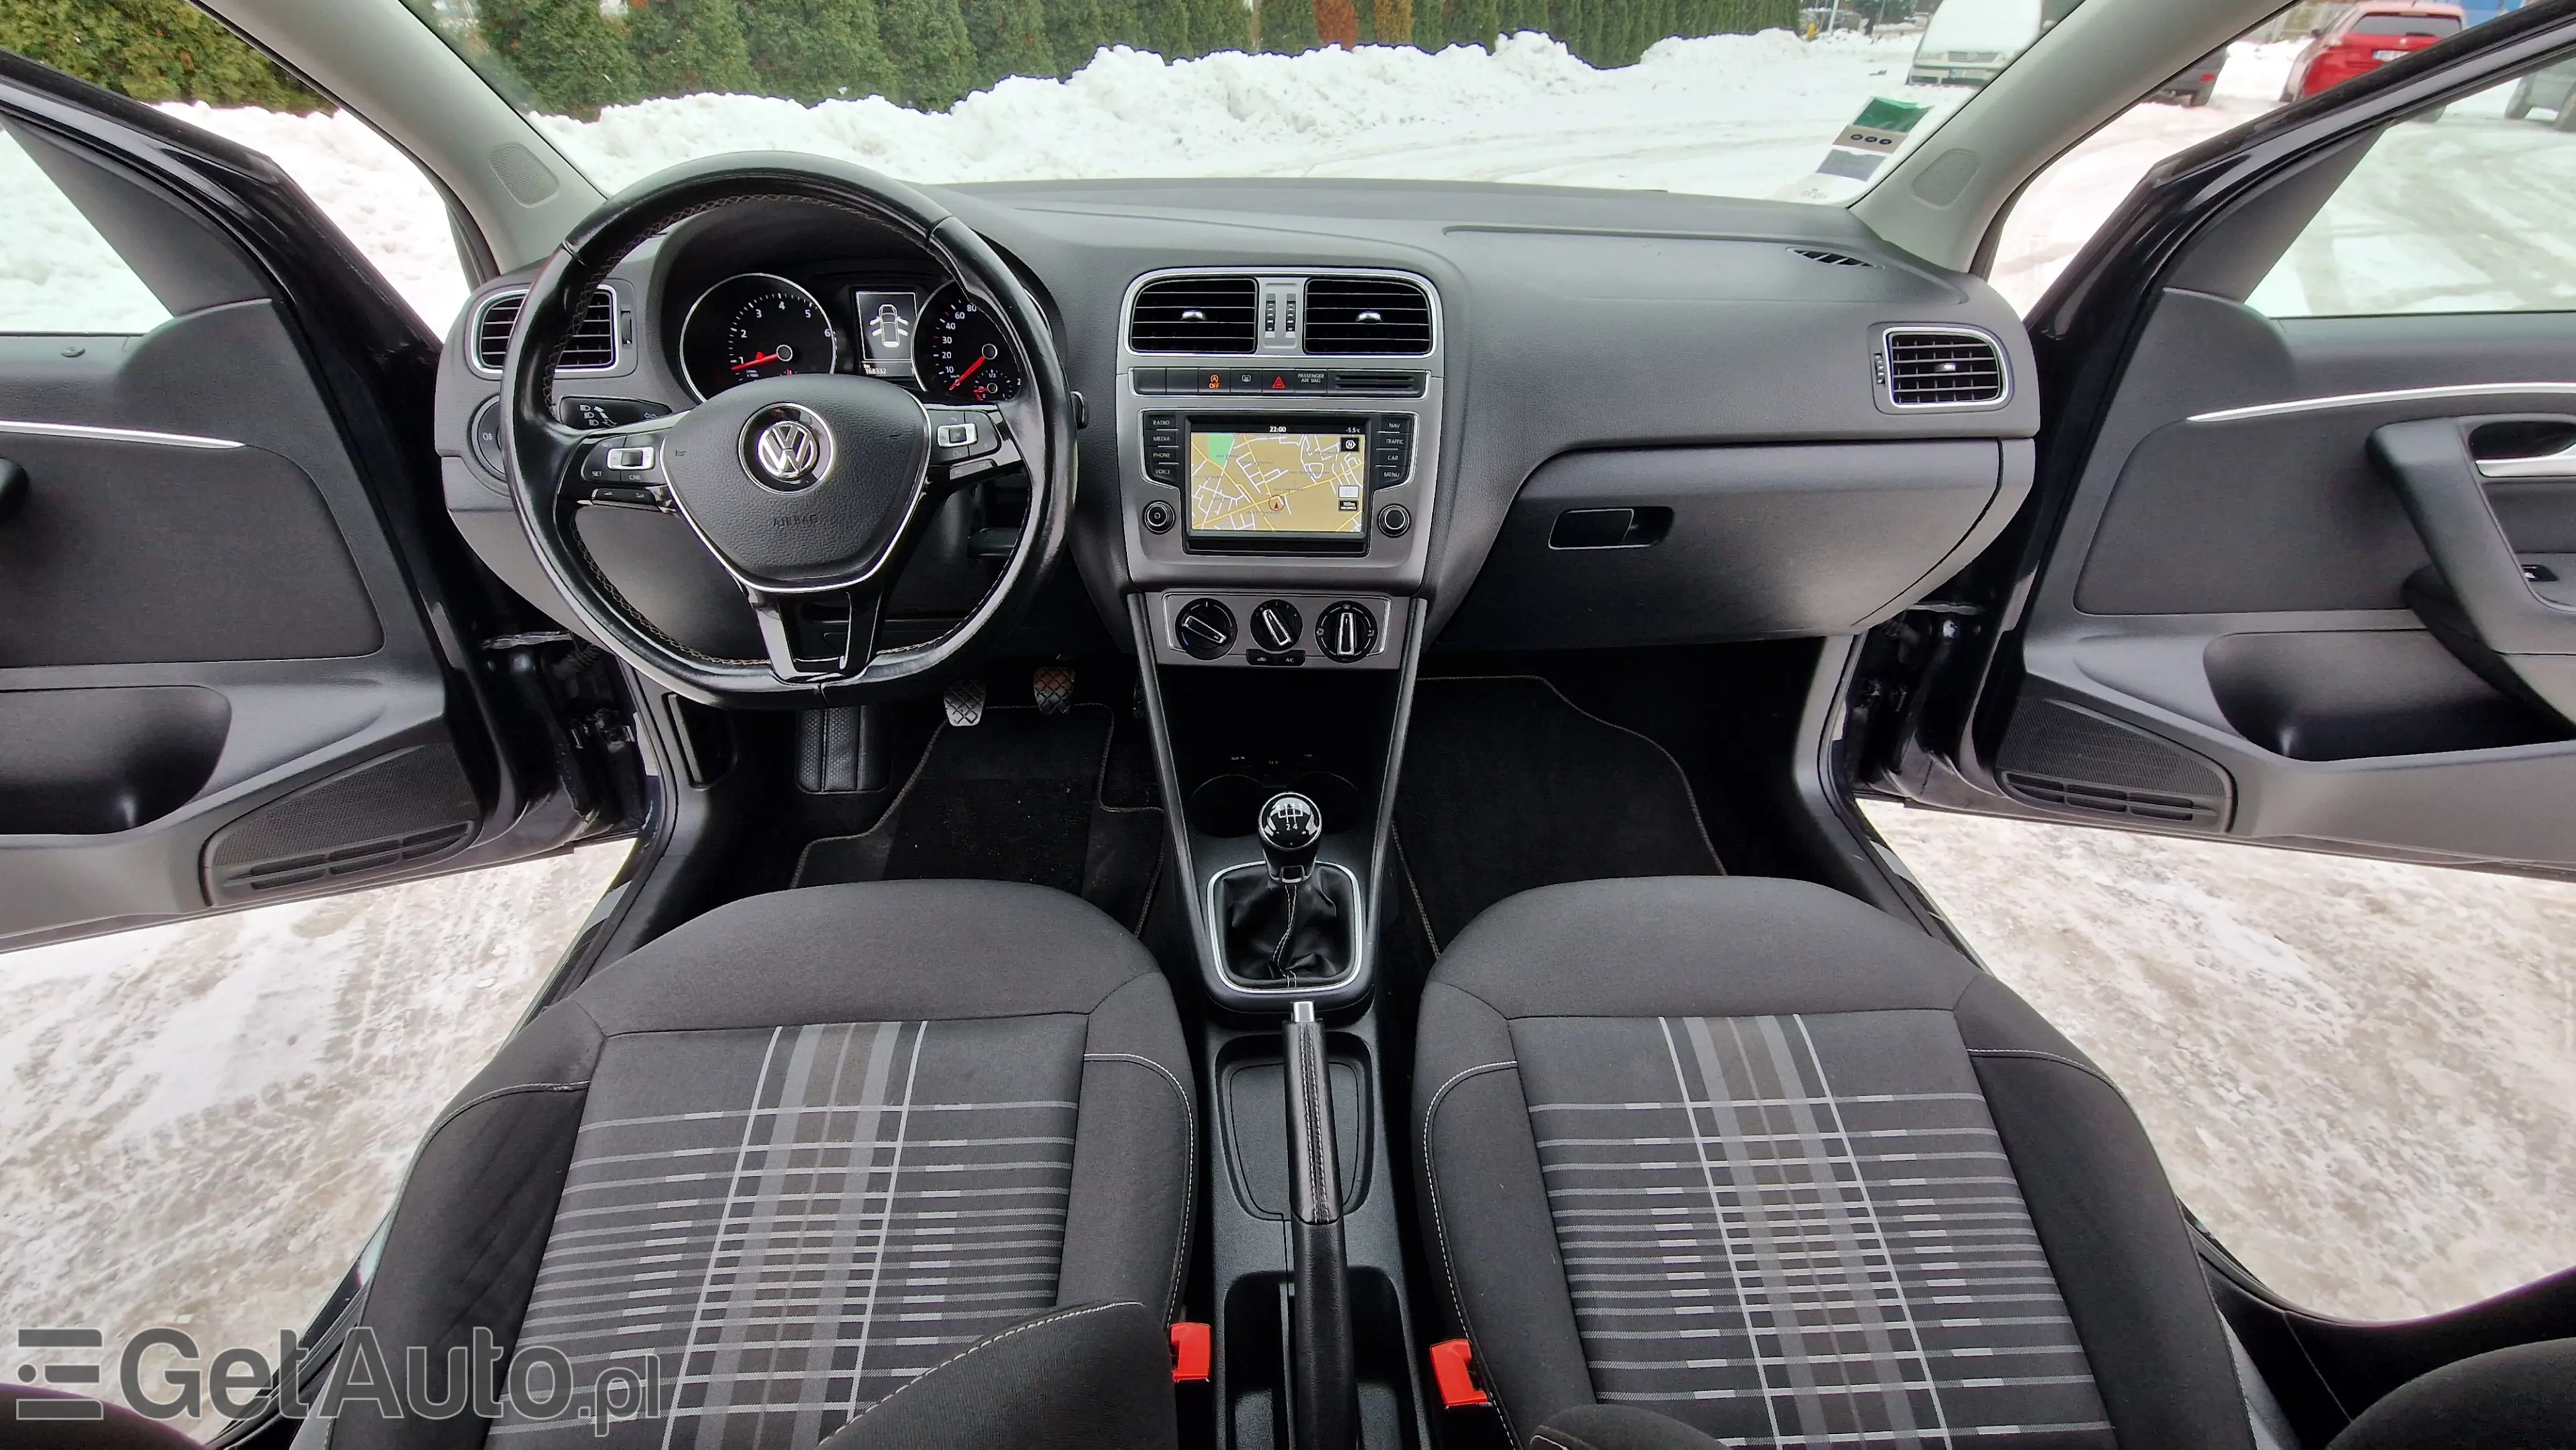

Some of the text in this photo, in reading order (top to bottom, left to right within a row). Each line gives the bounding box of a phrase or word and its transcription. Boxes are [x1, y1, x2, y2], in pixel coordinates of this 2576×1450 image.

[778, 301, 786, 311] 4
[755, 309, 762, 318] 3
[805, 309, 811, 318] 5
[741, 329, 747, 338] 2
[824, 329, 831, 337] 6
[739, 356, 744, 364] 1
[773, 514, 819, 526] AIRBAG
